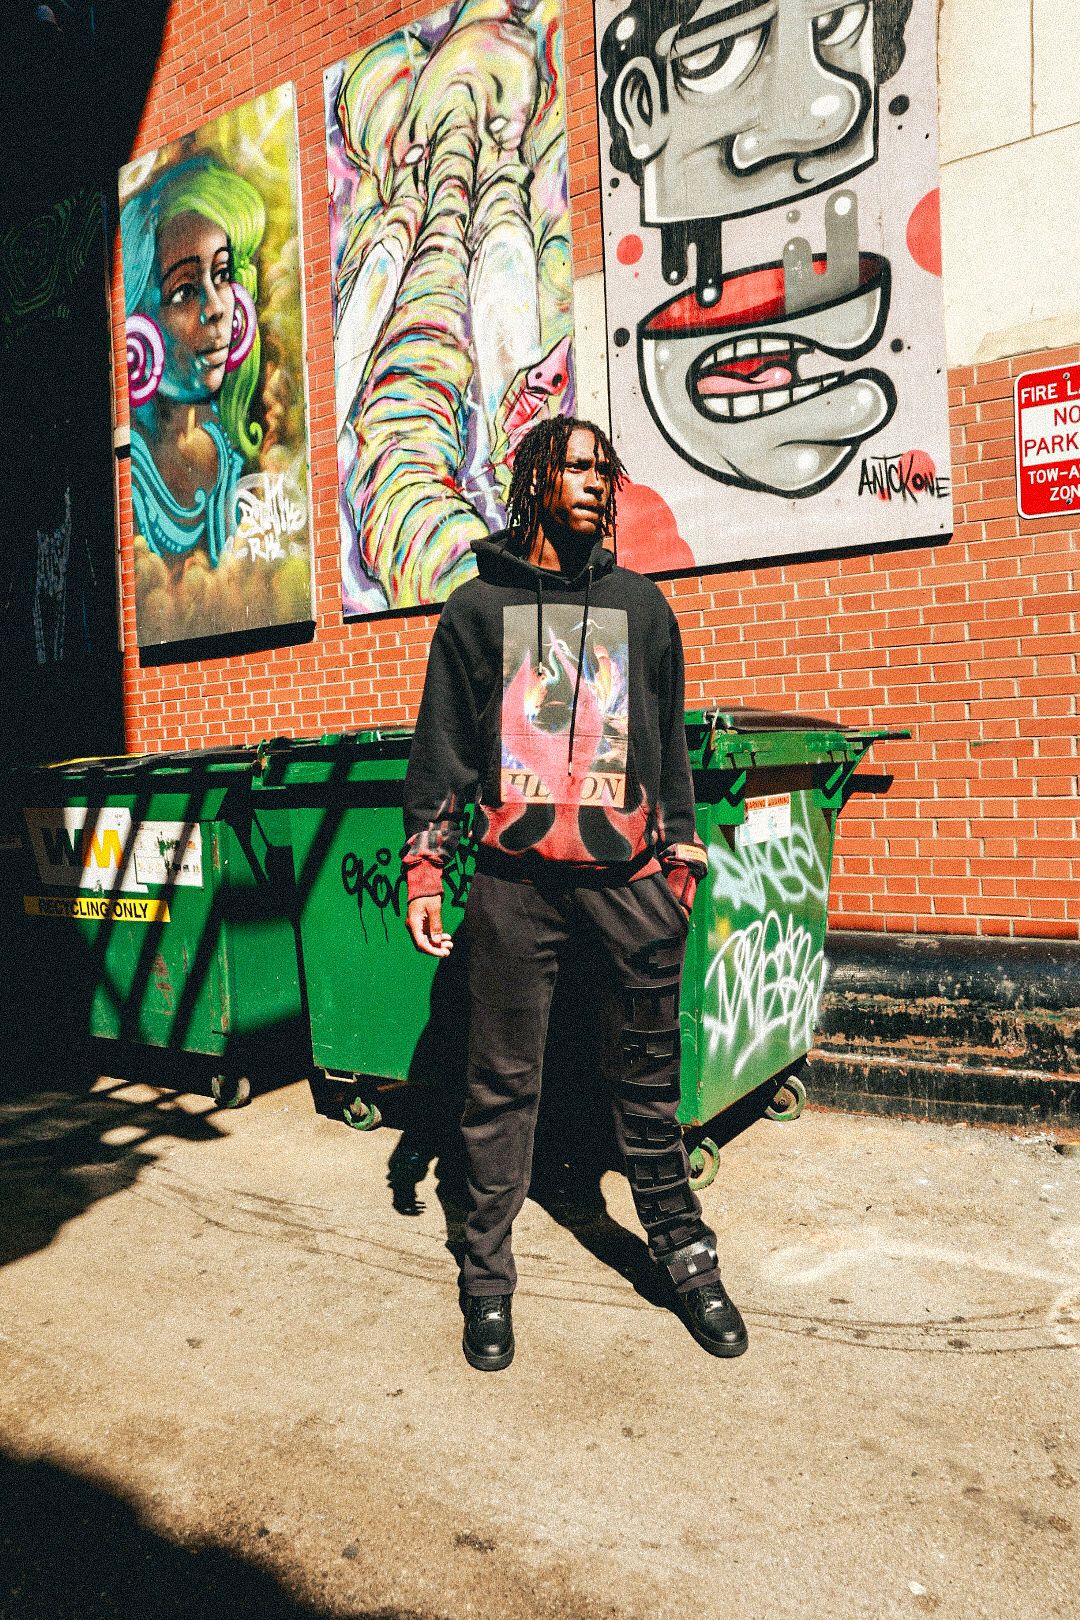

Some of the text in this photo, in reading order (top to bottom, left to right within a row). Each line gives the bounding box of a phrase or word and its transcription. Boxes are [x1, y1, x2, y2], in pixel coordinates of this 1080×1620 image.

[1021, 380, 1080, 405] FIRE L
[1053, 405, 1080, 427] NO
[1028, 465, 1080, 485] TOW-A
[41, 828, 125, 869] WM
[114, 902, 148, 919] ONLY
